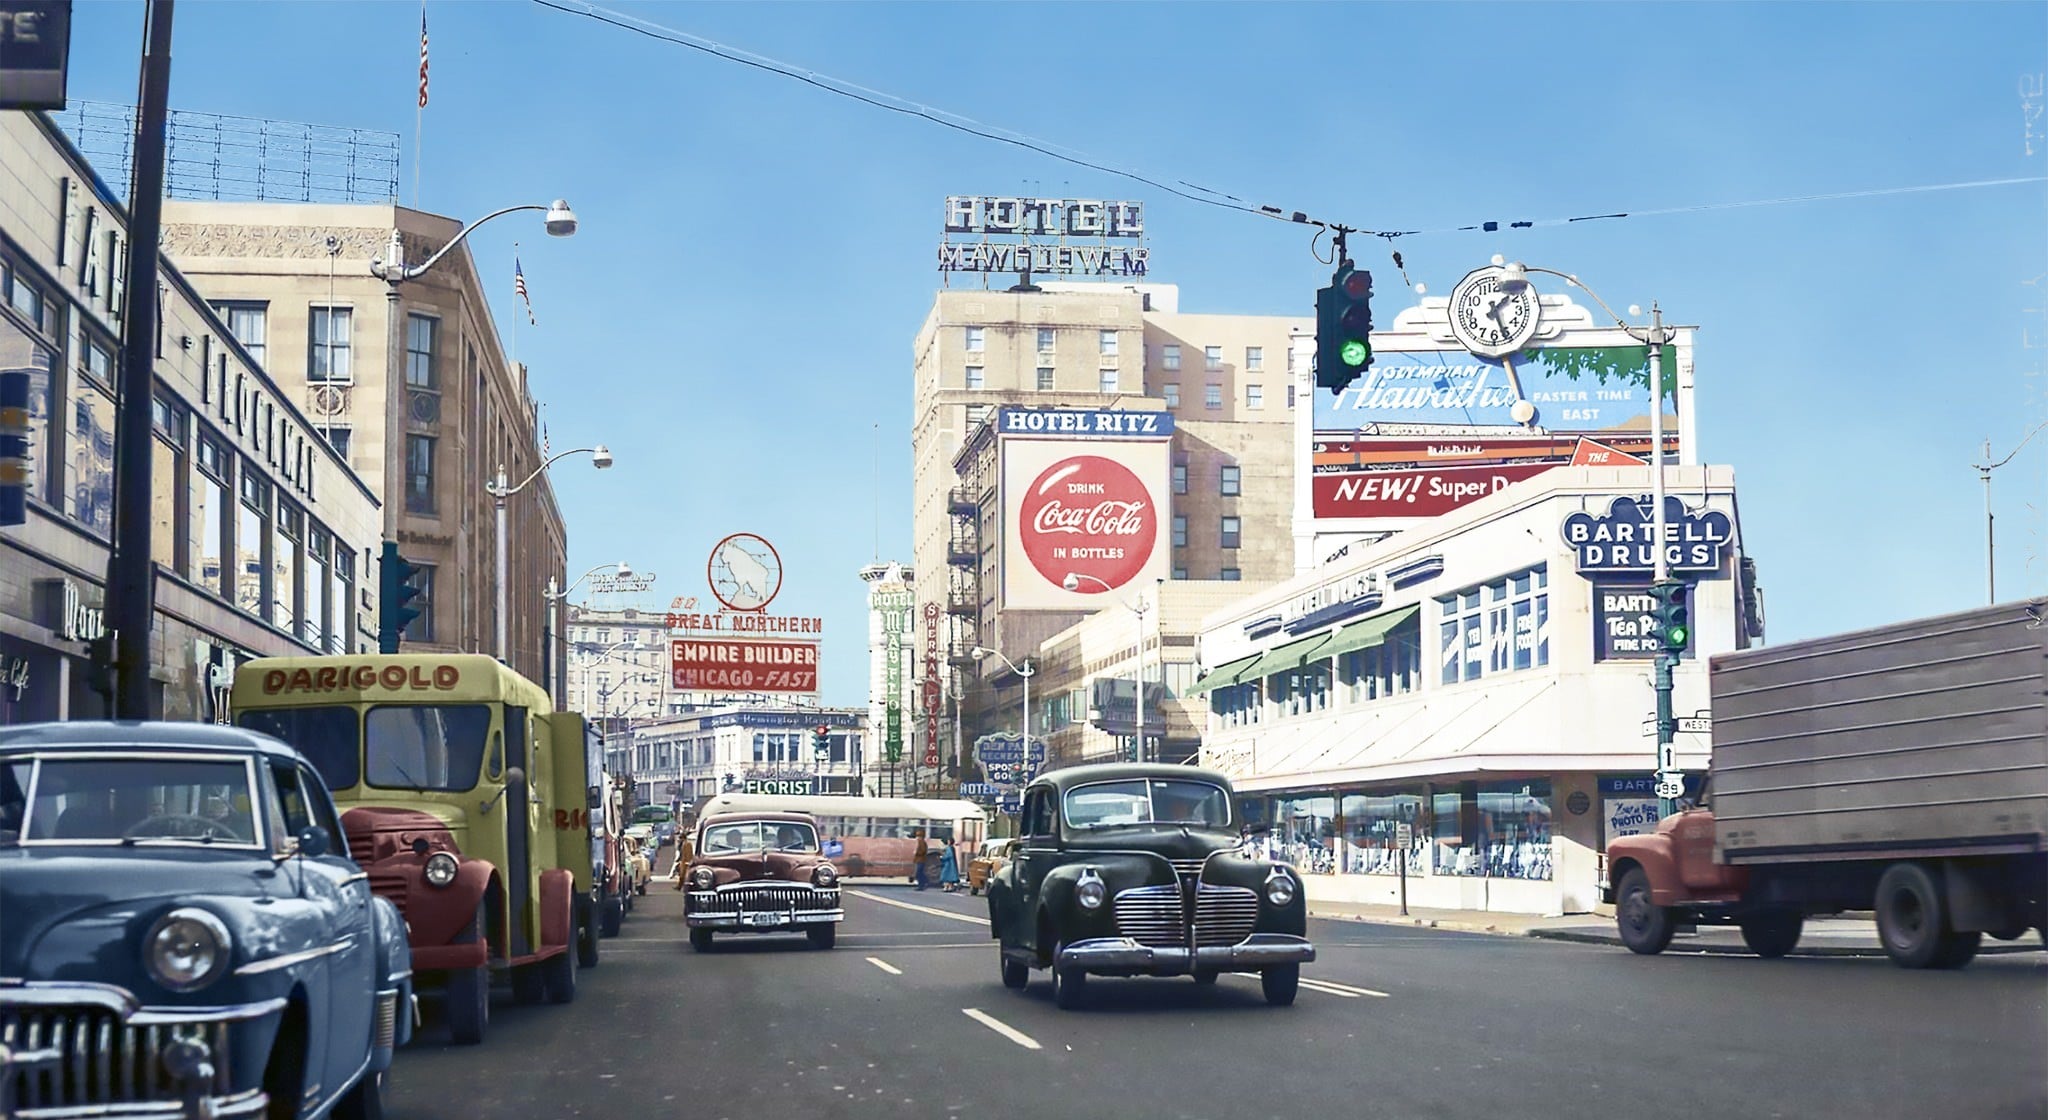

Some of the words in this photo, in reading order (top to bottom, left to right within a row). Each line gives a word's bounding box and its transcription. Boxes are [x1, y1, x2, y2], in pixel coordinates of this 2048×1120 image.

[946, 198, 1143, 232] HOTEL
[940, 242, 1150, 270] MAYFLOWER
[1468, 296, 1480, 306] 10
[1466, 308, 1473, 319] 9
[1515, 305, 1523, 316] 3
[1469, 317, 1478, 329] 8
[1509, 316, 1520, 327] 4
[1479, 328, 1487, 338] 7
[1490, 330, 1499, 341] 6
[1383, 366, 1477, 380] OLYMPIAN
[1533, 391, 1588, 402] FASTER
[1596, 390, 1632, 400] TIME
[1562, 408, 1600, 420] EAST
[1006, 412, 1090, 431] HOTEL
[1095, 413, 1158, 432] RITZ
[1588, 452, 1610, 462] THE
[1067, 483, 1105, 494] DRINK
[1333, 475, 1425, 503] NEW!
[1429, 477, 1488, 502] Super
[1034, 500, 1146, 535] Coca-Cola
[1571, 523, 1723, 542] BARTELL
[1053, 548, 1067, 558] IN
[1071, 548, 1124, 559] BOTTLES
[1586, 545, 1710, 565] DRUGS
[873, 593, 914, 606] HOTEL
[1603, 595, 1657, 612] BART
[665, 613, 722, 630] GREAT
[733, 616, 822, 633] NORTHERN
[1641, 639, 1658, 651] FO
[673, 644, 740, 662] EMPIRE
[744, 645, 815, 665] BUILDER
[264, 665, 460, 695] DARIGOLD
[747, 780, 813, 794] FLORIST
[1613, 780, 1655, 791] BART
[1662, 783, 1679, 795] 99
